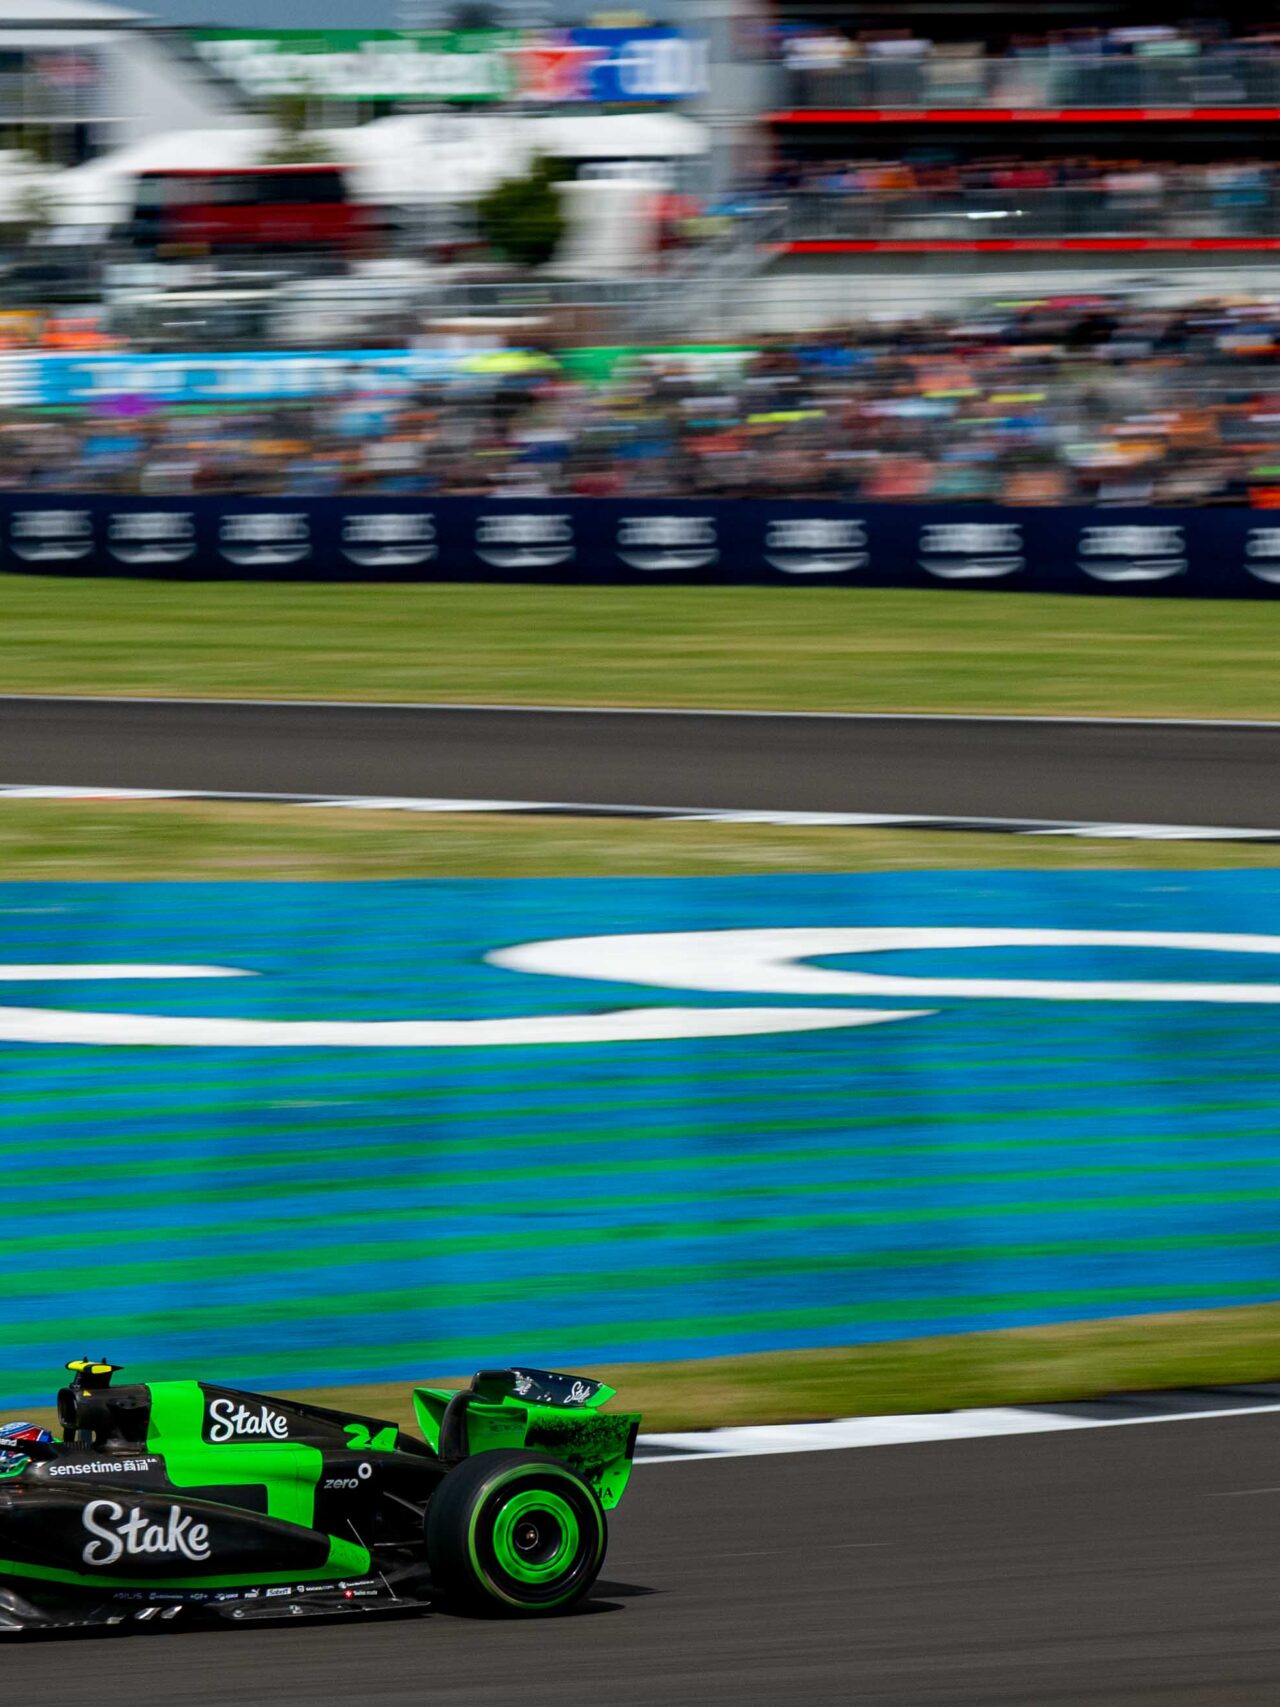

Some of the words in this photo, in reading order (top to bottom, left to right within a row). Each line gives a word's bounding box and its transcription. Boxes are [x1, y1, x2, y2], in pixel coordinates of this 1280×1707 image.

[210, 1399, 289, 1442] Stake
[343, 1423, 398, 1452] 24
[49, 1461, 122, 1476] sensetime
[323, 1477, 358, 1489] zero
[82, 1500, 211, 1566] Stake
